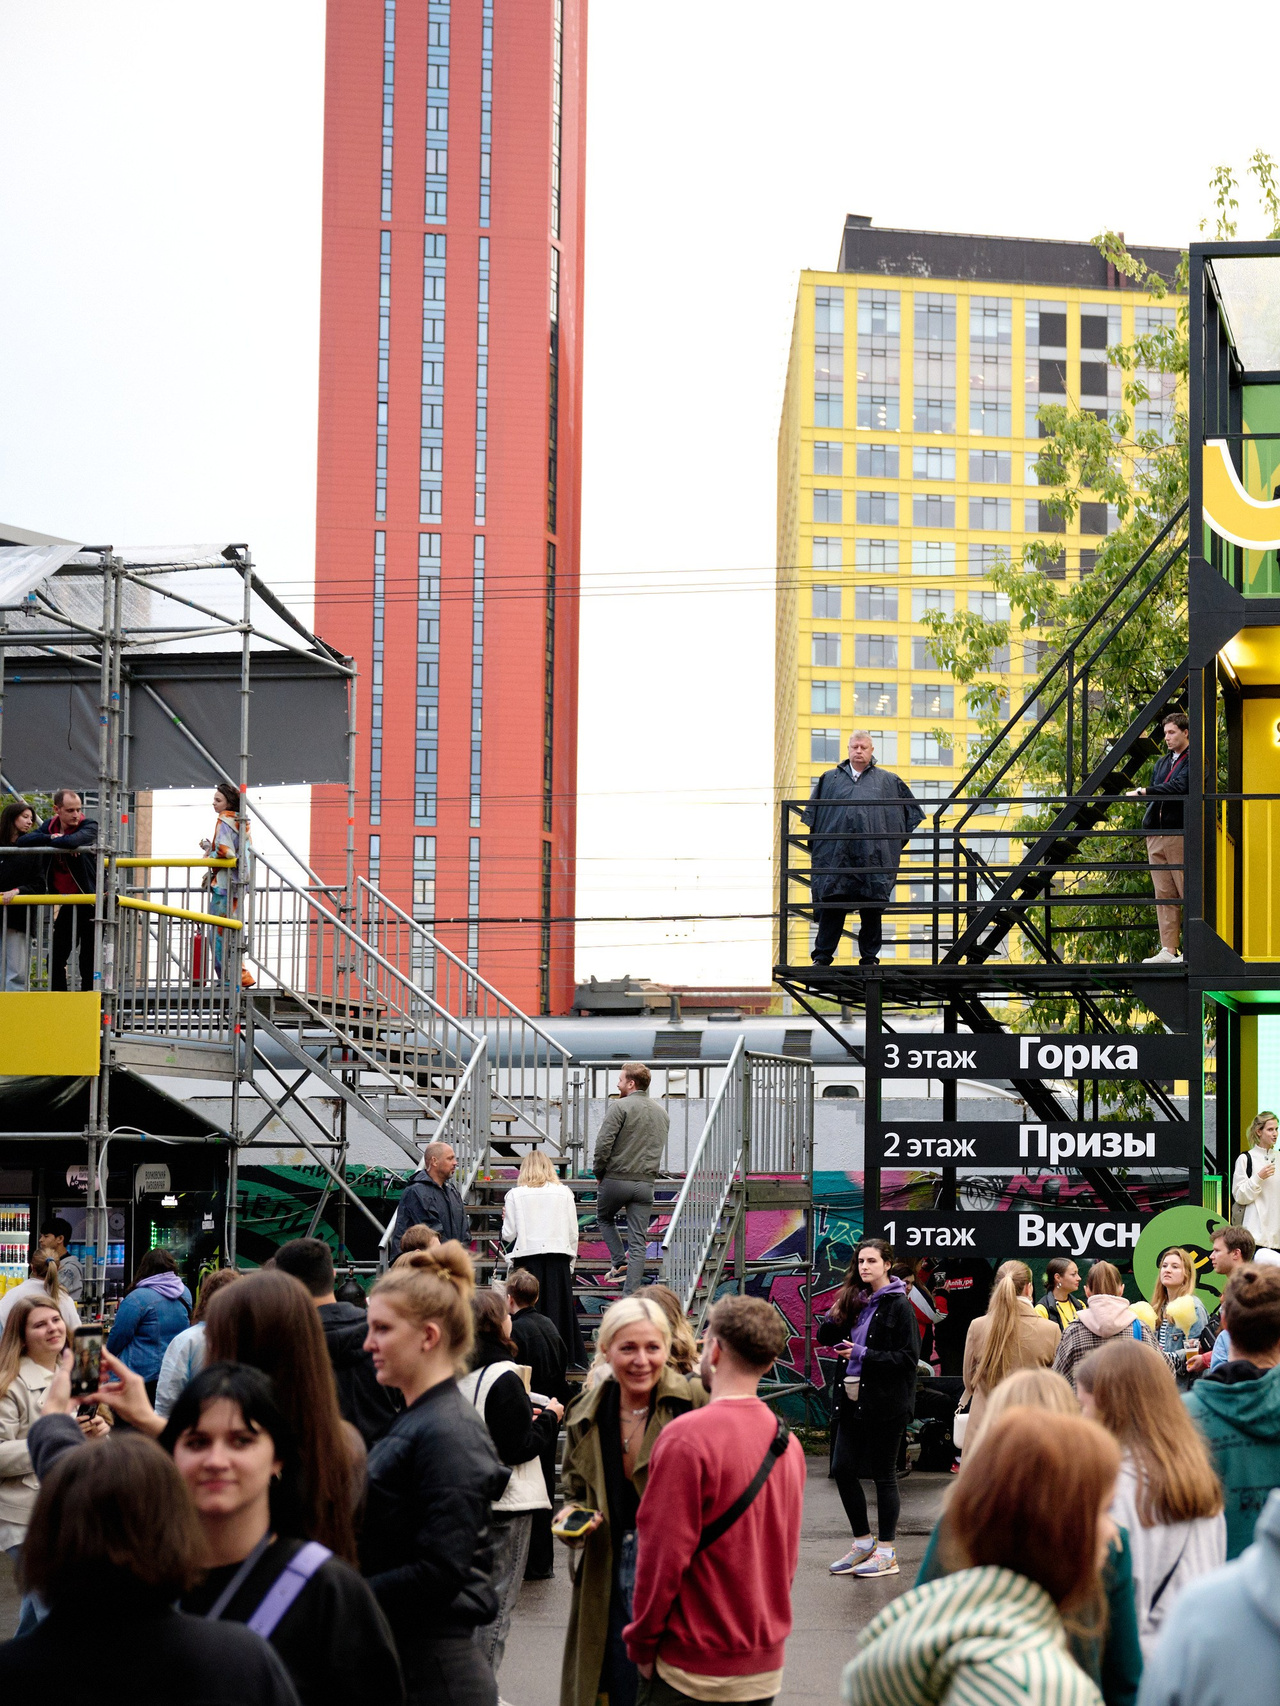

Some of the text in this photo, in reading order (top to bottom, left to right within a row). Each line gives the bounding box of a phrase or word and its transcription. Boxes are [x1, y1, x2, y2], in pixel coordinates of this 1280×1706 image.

[883, 1036, 1139, 1077] 3 этаж Горка
[883, 1124, 1156, 1165] 2 этаж Призы
[883, 1213, 1141, 1256] 1 этаж Вкусн
